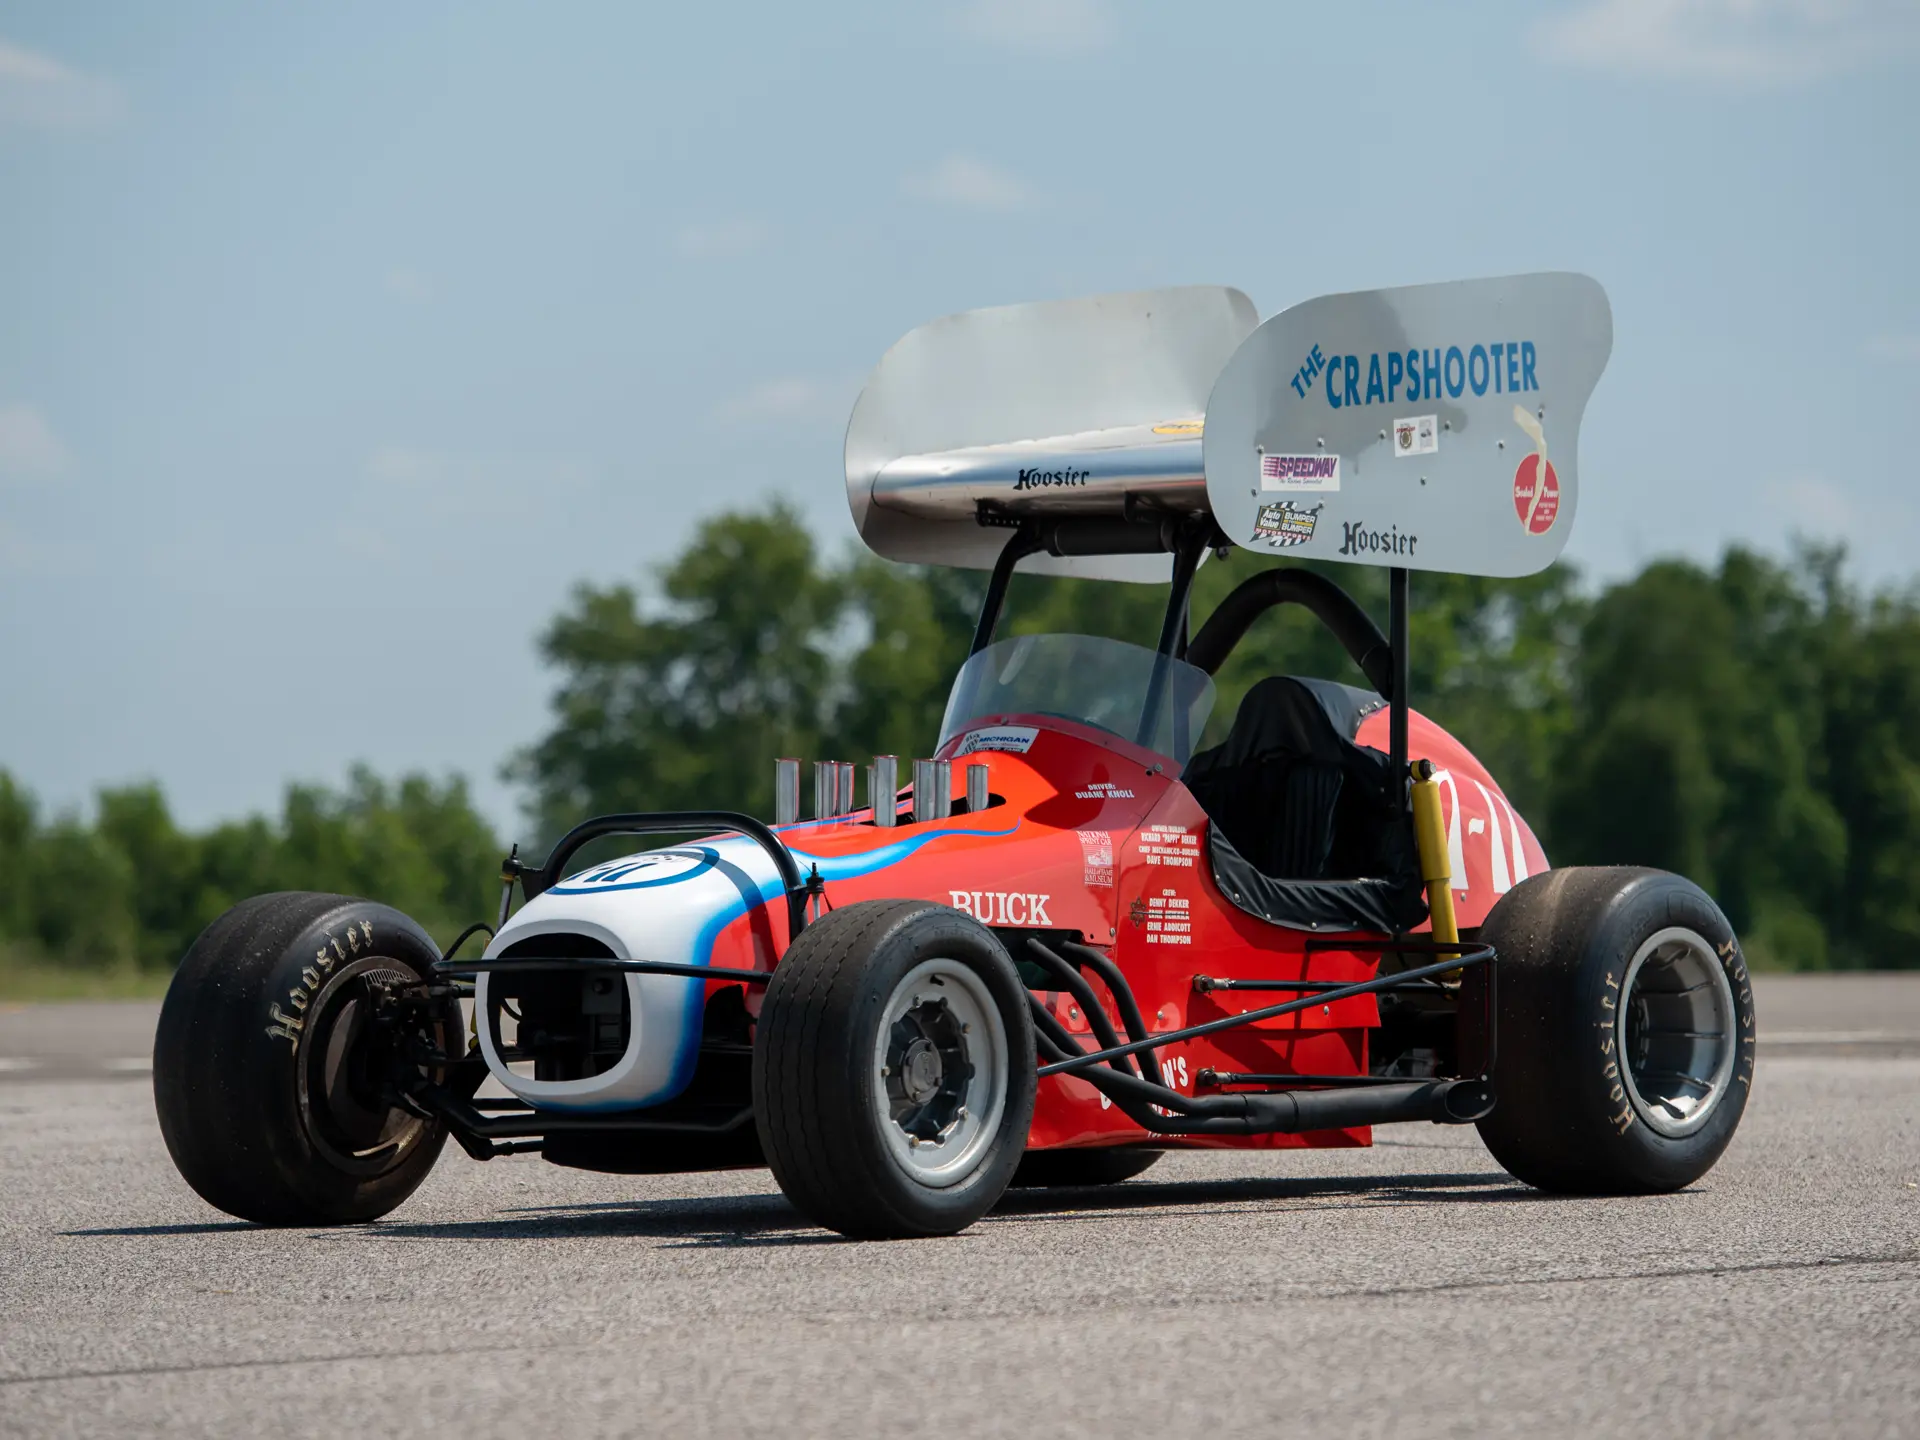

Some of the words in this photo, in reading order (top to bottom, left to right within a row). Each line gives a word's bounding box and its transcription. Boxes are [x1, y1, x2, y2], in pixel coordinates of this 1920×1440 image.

[1290, 343, 1327, 399] THE
[1326, 341, 1540, 409] CRAPSHOOTER
[1278, 457, 1337, 478] SPEEDWAY
[1013, 466, 1090, 490] Hoosier
[1263, 509, 1280, 520] Auto
[1284, 511, 1316, 524] BUMPER
[1260, 517, 1279, 529] Value
[1281, 523, 1313, 535] BUMPER
[1255, 527, 1312, 541] MOTORSPORTS
[1338, 521, 1418, 557] Hoosier
[979, 736, 1030, 744] MICHIGAN
[1088, 783, 1116, 791] DRIVER:
[1075, 790, 1105, 799] DUANE
[1106, 789, 1135, 798] KNOLL
[1076, 830, 1111, 839] NATIONAL
[1079, 837, 1100, 845] SPRINT
[1100, 838, 1112, 846] CAR
[1146, 855, 1161, 866] DAVE
[1163, 855, 1193, 867] THOMPSON
[949, 890, 1053, 926] BUICK
[1149, 897, 1167, 908] DENNY
[1168, 898, 1190, 909] DEKKER
[1147, 921, 1162, 932] ERNIE
[1146, 933, 1159, 944] DAN
[1160, 933, 1192, 945] THOMPSON
[265, 920, 374, 1056] Hoosier
[1593, 971, 1635, 1136] Hoosier
